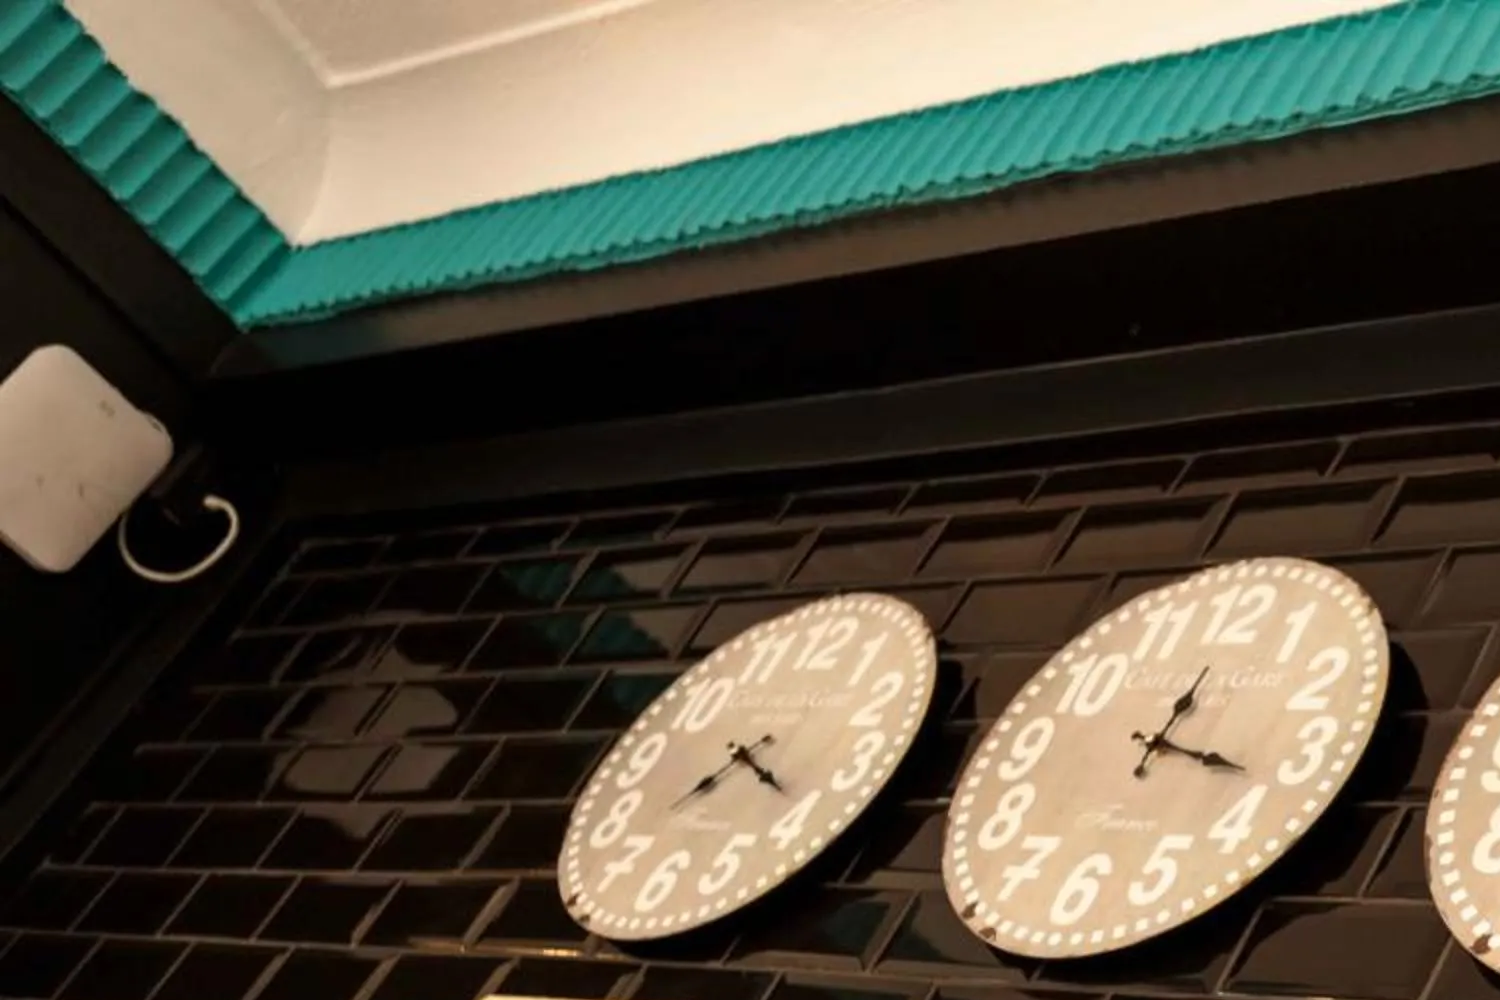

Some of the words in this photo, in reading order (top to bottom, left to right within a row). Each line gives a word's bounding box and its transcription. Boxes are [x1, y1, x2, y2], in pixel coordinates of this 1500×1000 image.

[794, 618, 858, 669] 12
[1133, 602, 1198, 661] 11
[1202, 585, 1276, 644] 12
[1277, 602, 1316, 662] 1
[739, 633, 797, 684] 11
[848, 632, 888, 685] 1
[1057, 654, 1128, 715] 10
[1287, 647, 1348, 709] 2
[672, 678, 735, 732] 10
[850, 672, 903, 726] 2
[617, 733, 666, 788] 9
[831, 731, 885, 791] 3
[999, 717, 1054, 780] 9
[1278, 716, 1338, 784] 3
[590, 791, 642, 848] 8
[769, 790, 821, 849] 4
[979, 783, 1035, 850] 8
[1208, 785, 1267, 853] 4
[598, 834, 655, 893] 7
[635, 851, 690, 911] 6
[698, 834, 756, 895] 5
[998, 836, 1061, 900] 7
[1050, 854, 1111, 924] 6
[1129, 835, 1193, 905] 5
